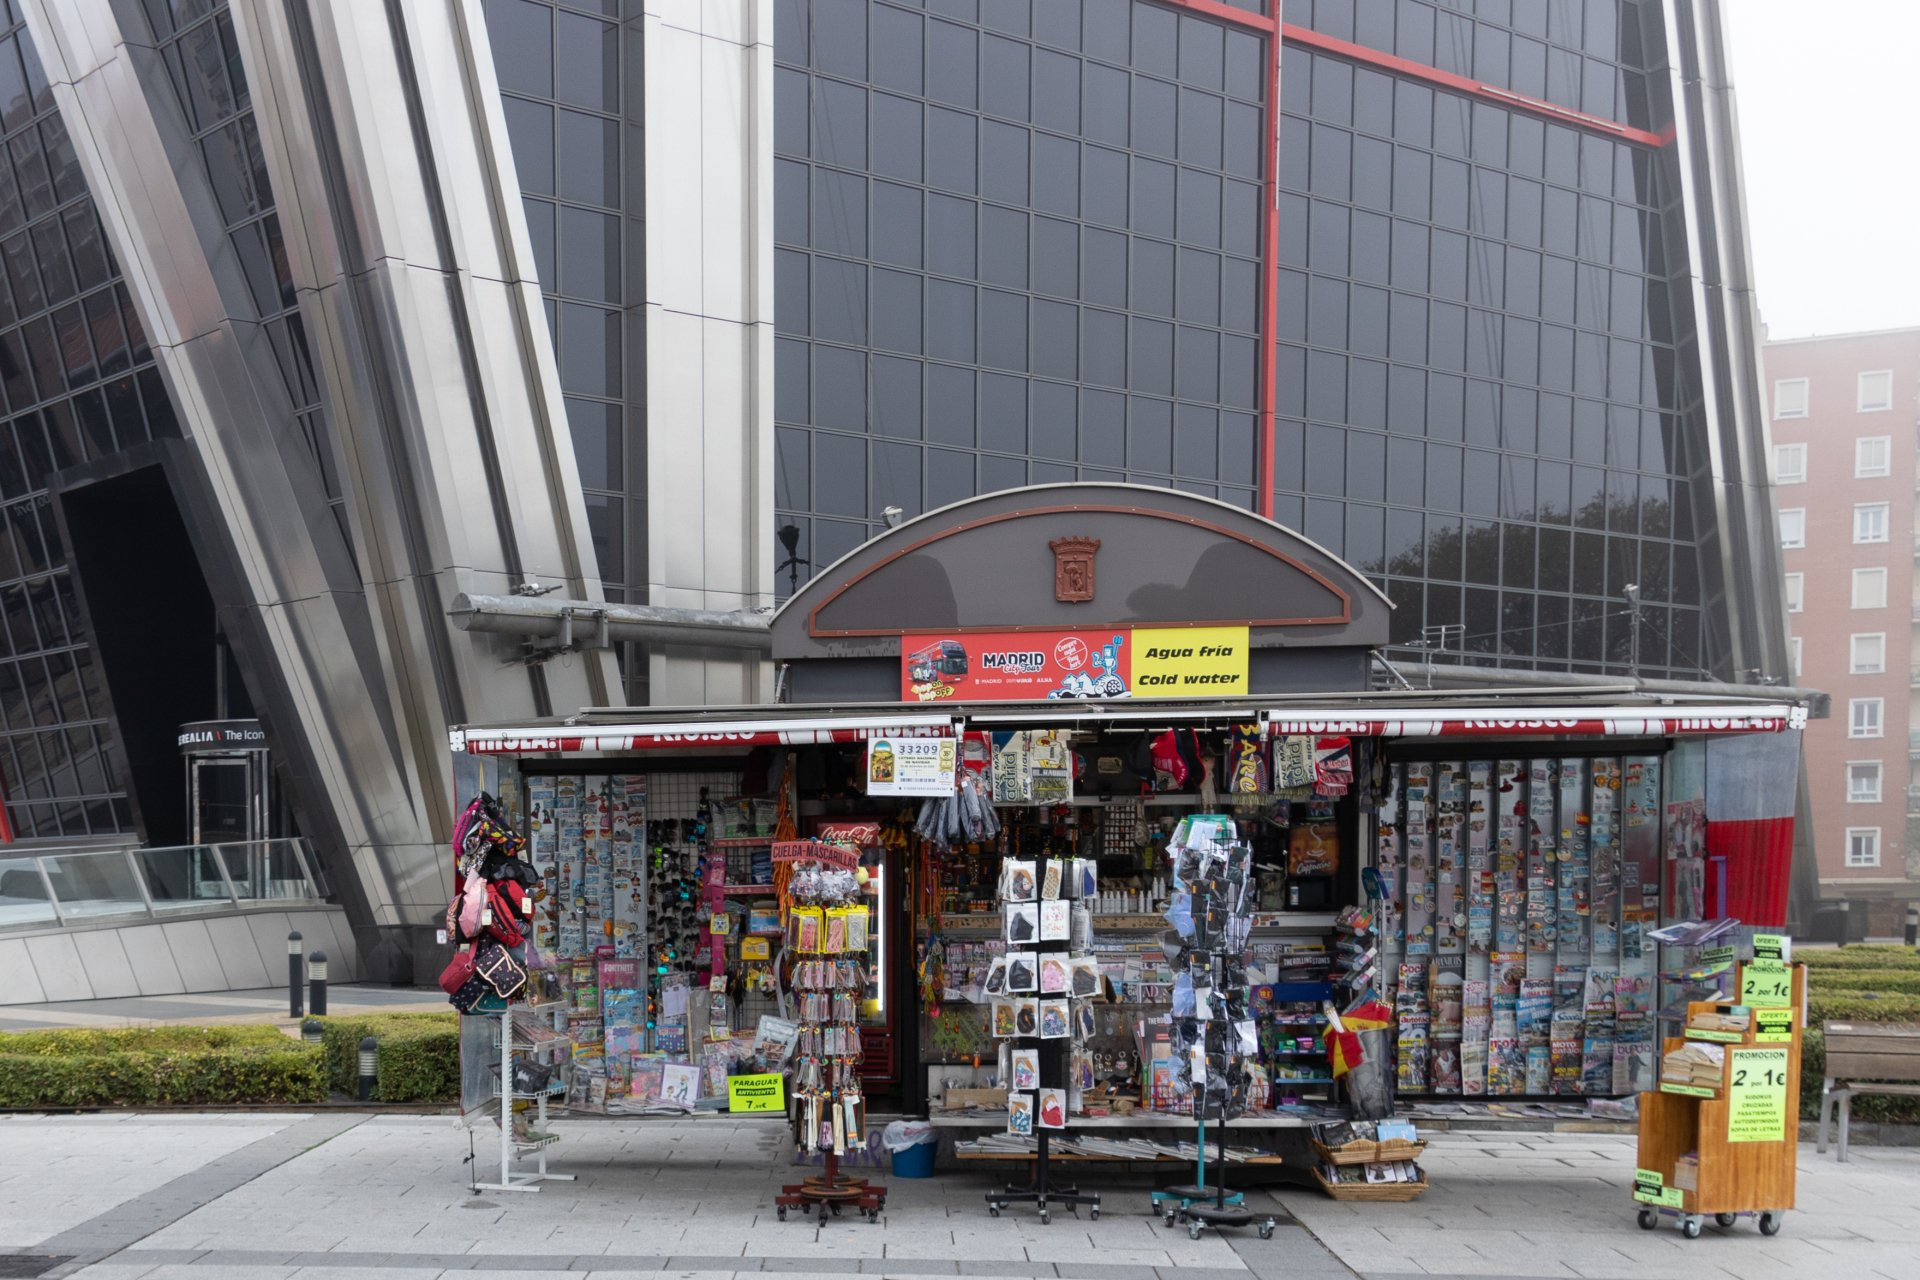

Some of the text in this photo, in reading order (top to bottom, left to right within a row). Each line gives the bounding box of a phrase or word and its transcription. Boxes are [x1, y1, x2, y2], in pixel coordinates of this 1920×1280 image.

[1145, 645, 1233, 659] Agua fría
[983, 653, 1045, 667] MADRID
[1139, 673, 1240, 686] Cold water
[225, 730, 265, 740] The Icon
[899, 745, 938, 754] 33209
[1744, 980, 1756, 994] 2
[734, 1078, 778, 1087] PARAGUAS
[1732, 1069, 1747, 1086] 2
